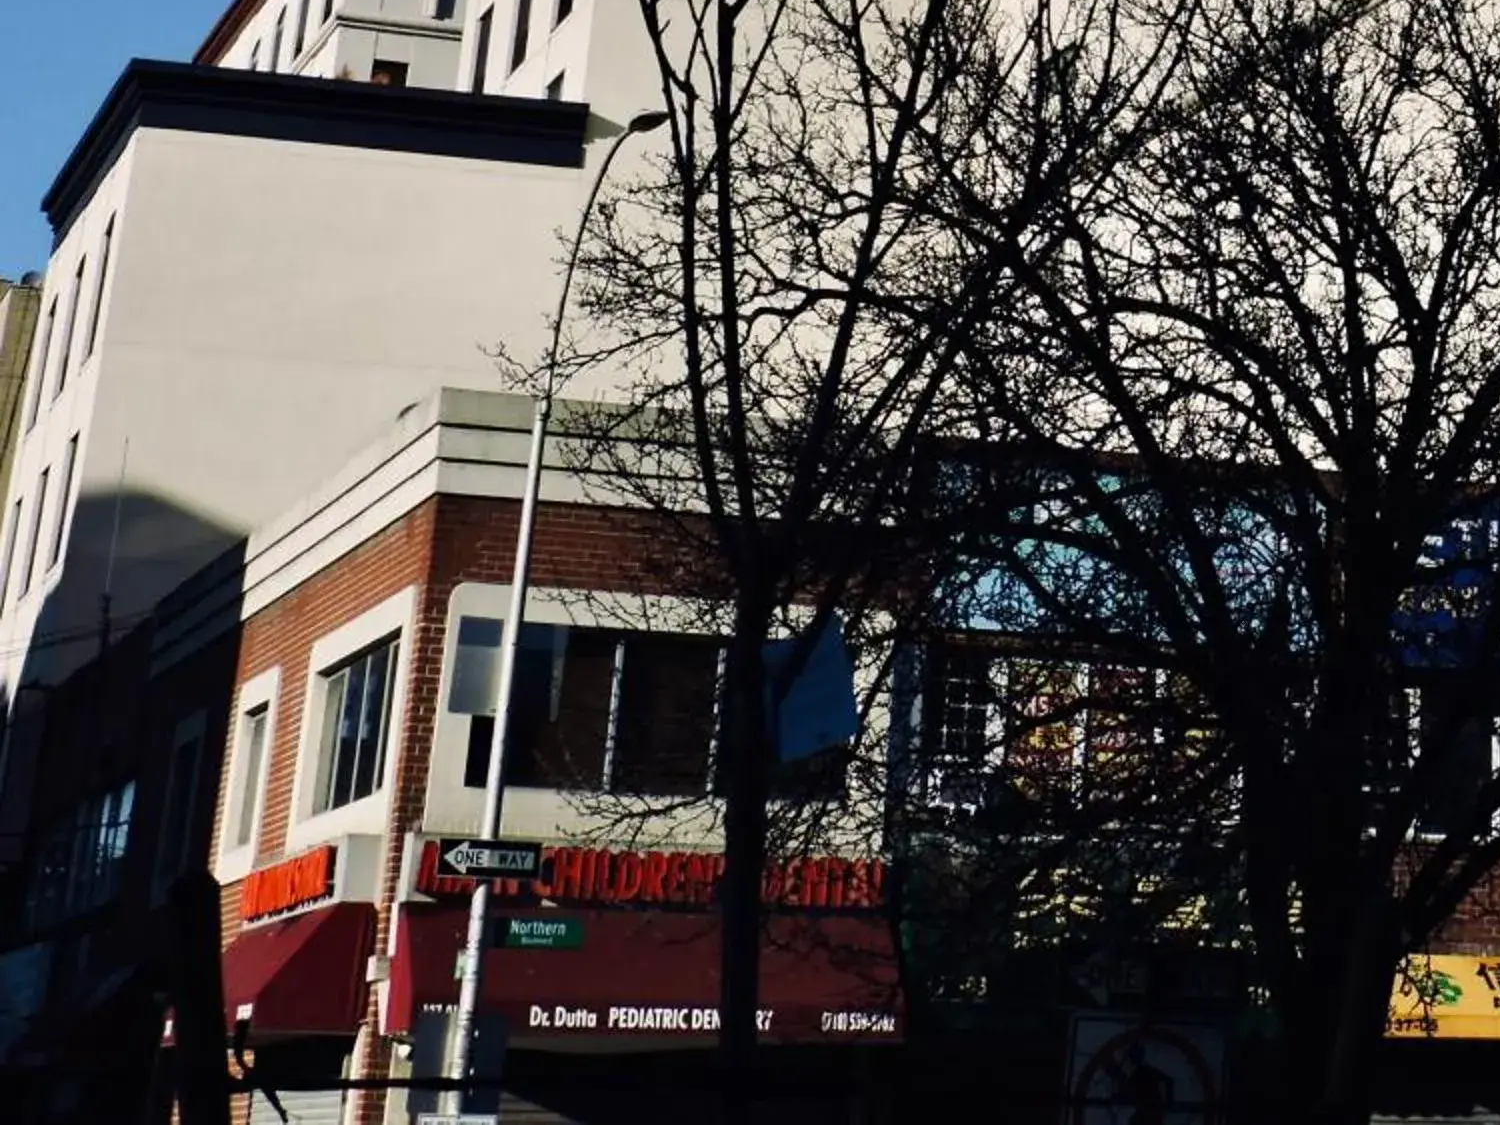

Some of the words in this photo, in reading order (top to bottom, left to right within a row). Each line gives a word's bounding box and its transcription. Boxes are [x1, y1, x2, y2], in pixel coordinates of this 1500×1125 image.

[454, 850, 483, 866] ONE
[497, 851, 530, 868] WAY
[534, 846, 727, 905] CHILDREN'
[509, 920, 567, 937] Northern
[529, 1005, 549, 1026] Dr.
[554, 1006, 597, 1028] Dutta
[607, 1007, 688, 1029] PEDIATRIC
[691, 1007, 774, 1031] DENRY
